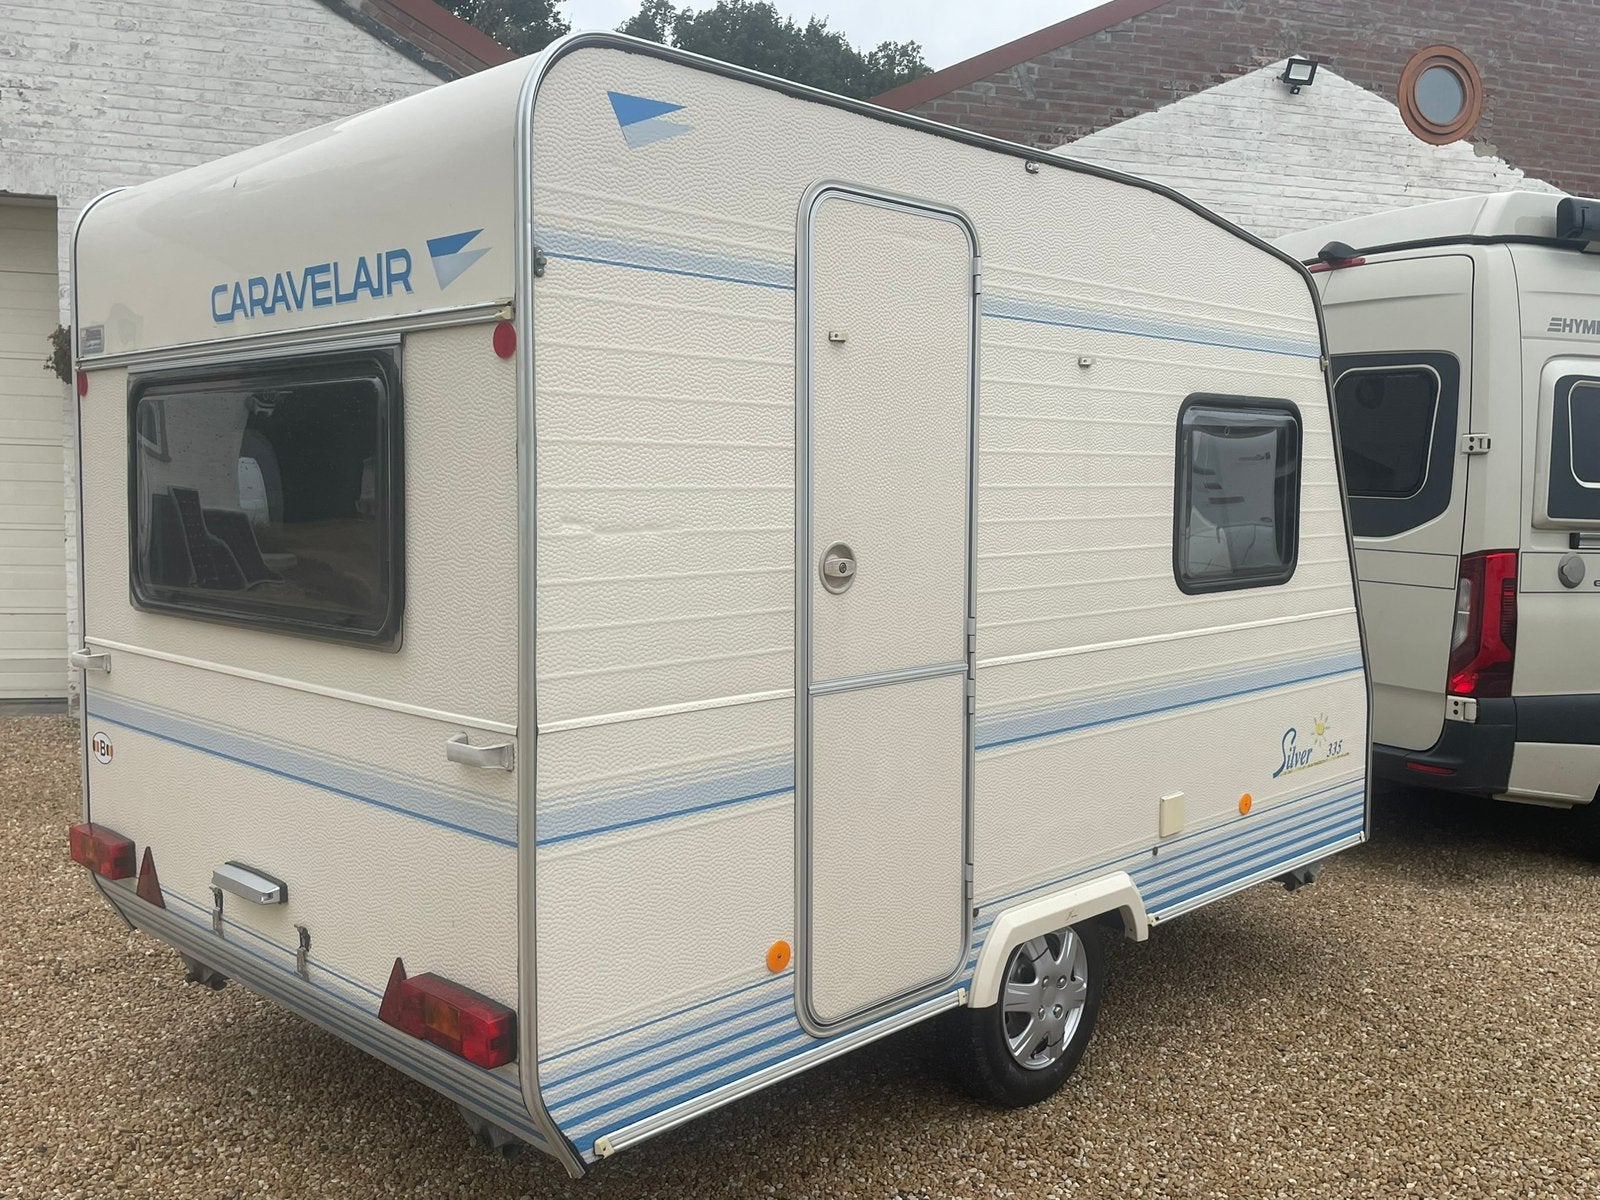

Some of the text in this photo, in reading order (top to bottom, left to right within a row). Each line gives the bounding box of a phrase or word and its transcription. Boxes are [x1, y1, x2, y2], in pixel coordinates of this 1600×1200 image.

[211, 248, 414, 324] CARAVELAIR
[100, 739, 106, 757] B
[1272, 727, 1313, 779] Silver
[1326, 739, 1343, 758] 335
